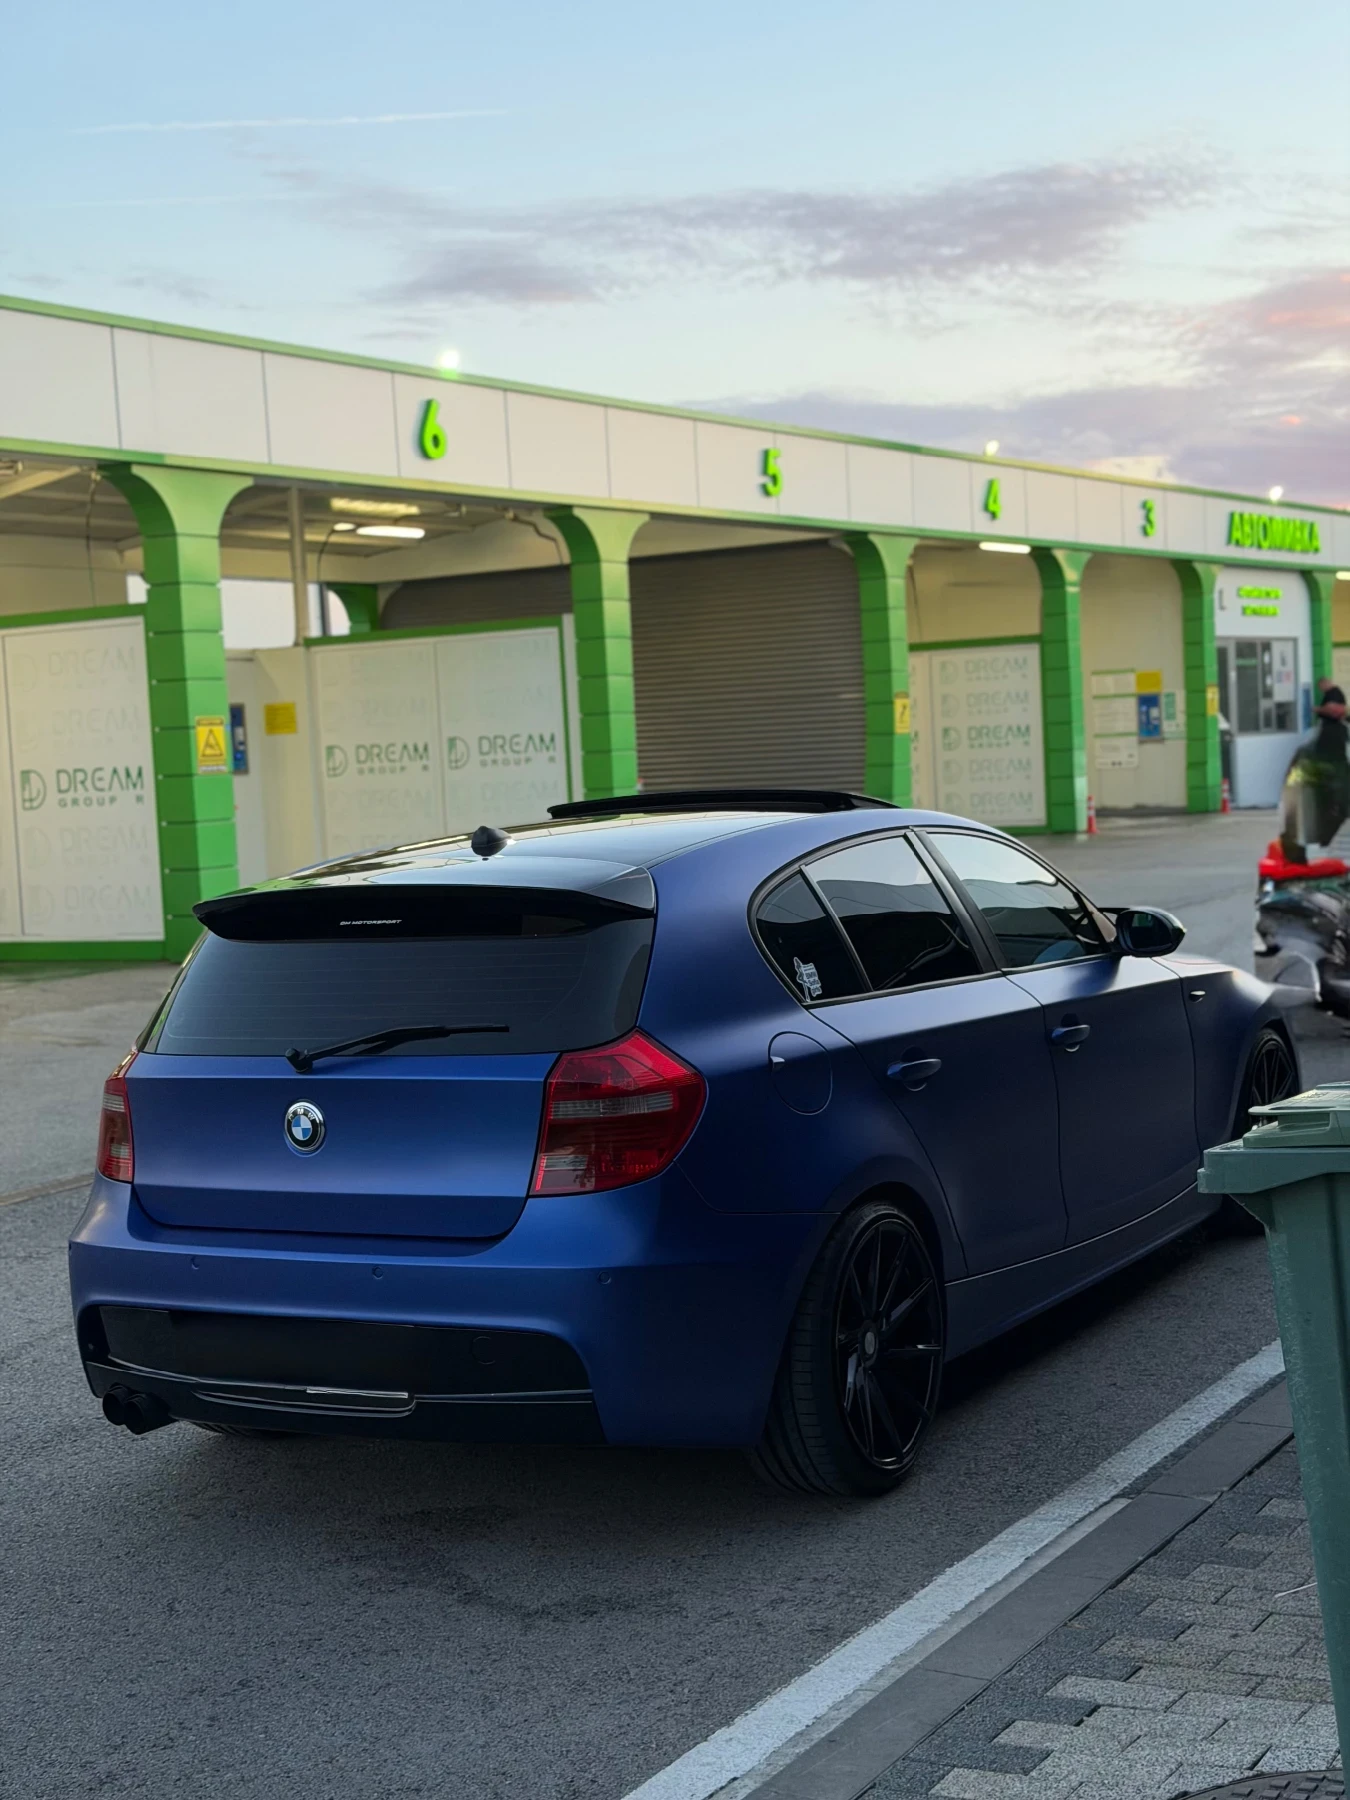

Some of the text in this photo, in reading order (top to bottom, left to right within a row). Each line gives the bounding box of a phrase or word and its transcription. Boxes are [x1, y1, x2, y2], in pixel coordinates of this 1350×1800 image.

[418, 398, 447, 460] 6
[761, 447, 783, 498] 5
[984, 477, 1002, 521] 4
[1140, 499, 1157, 538] 3
[478, 732, 557, 756] DREAM
[967, 723, 1031, 741] DREAM
[355, 741, 430, 765] DREAM
[479, 755, 534, 768] GROUP
[56, 766, 145, 794] DREAM
[356, 764, 408, 776] GROUP
[57, 795, 117, 809] GROUP
[288, 1108, 316, 1120] BMW
